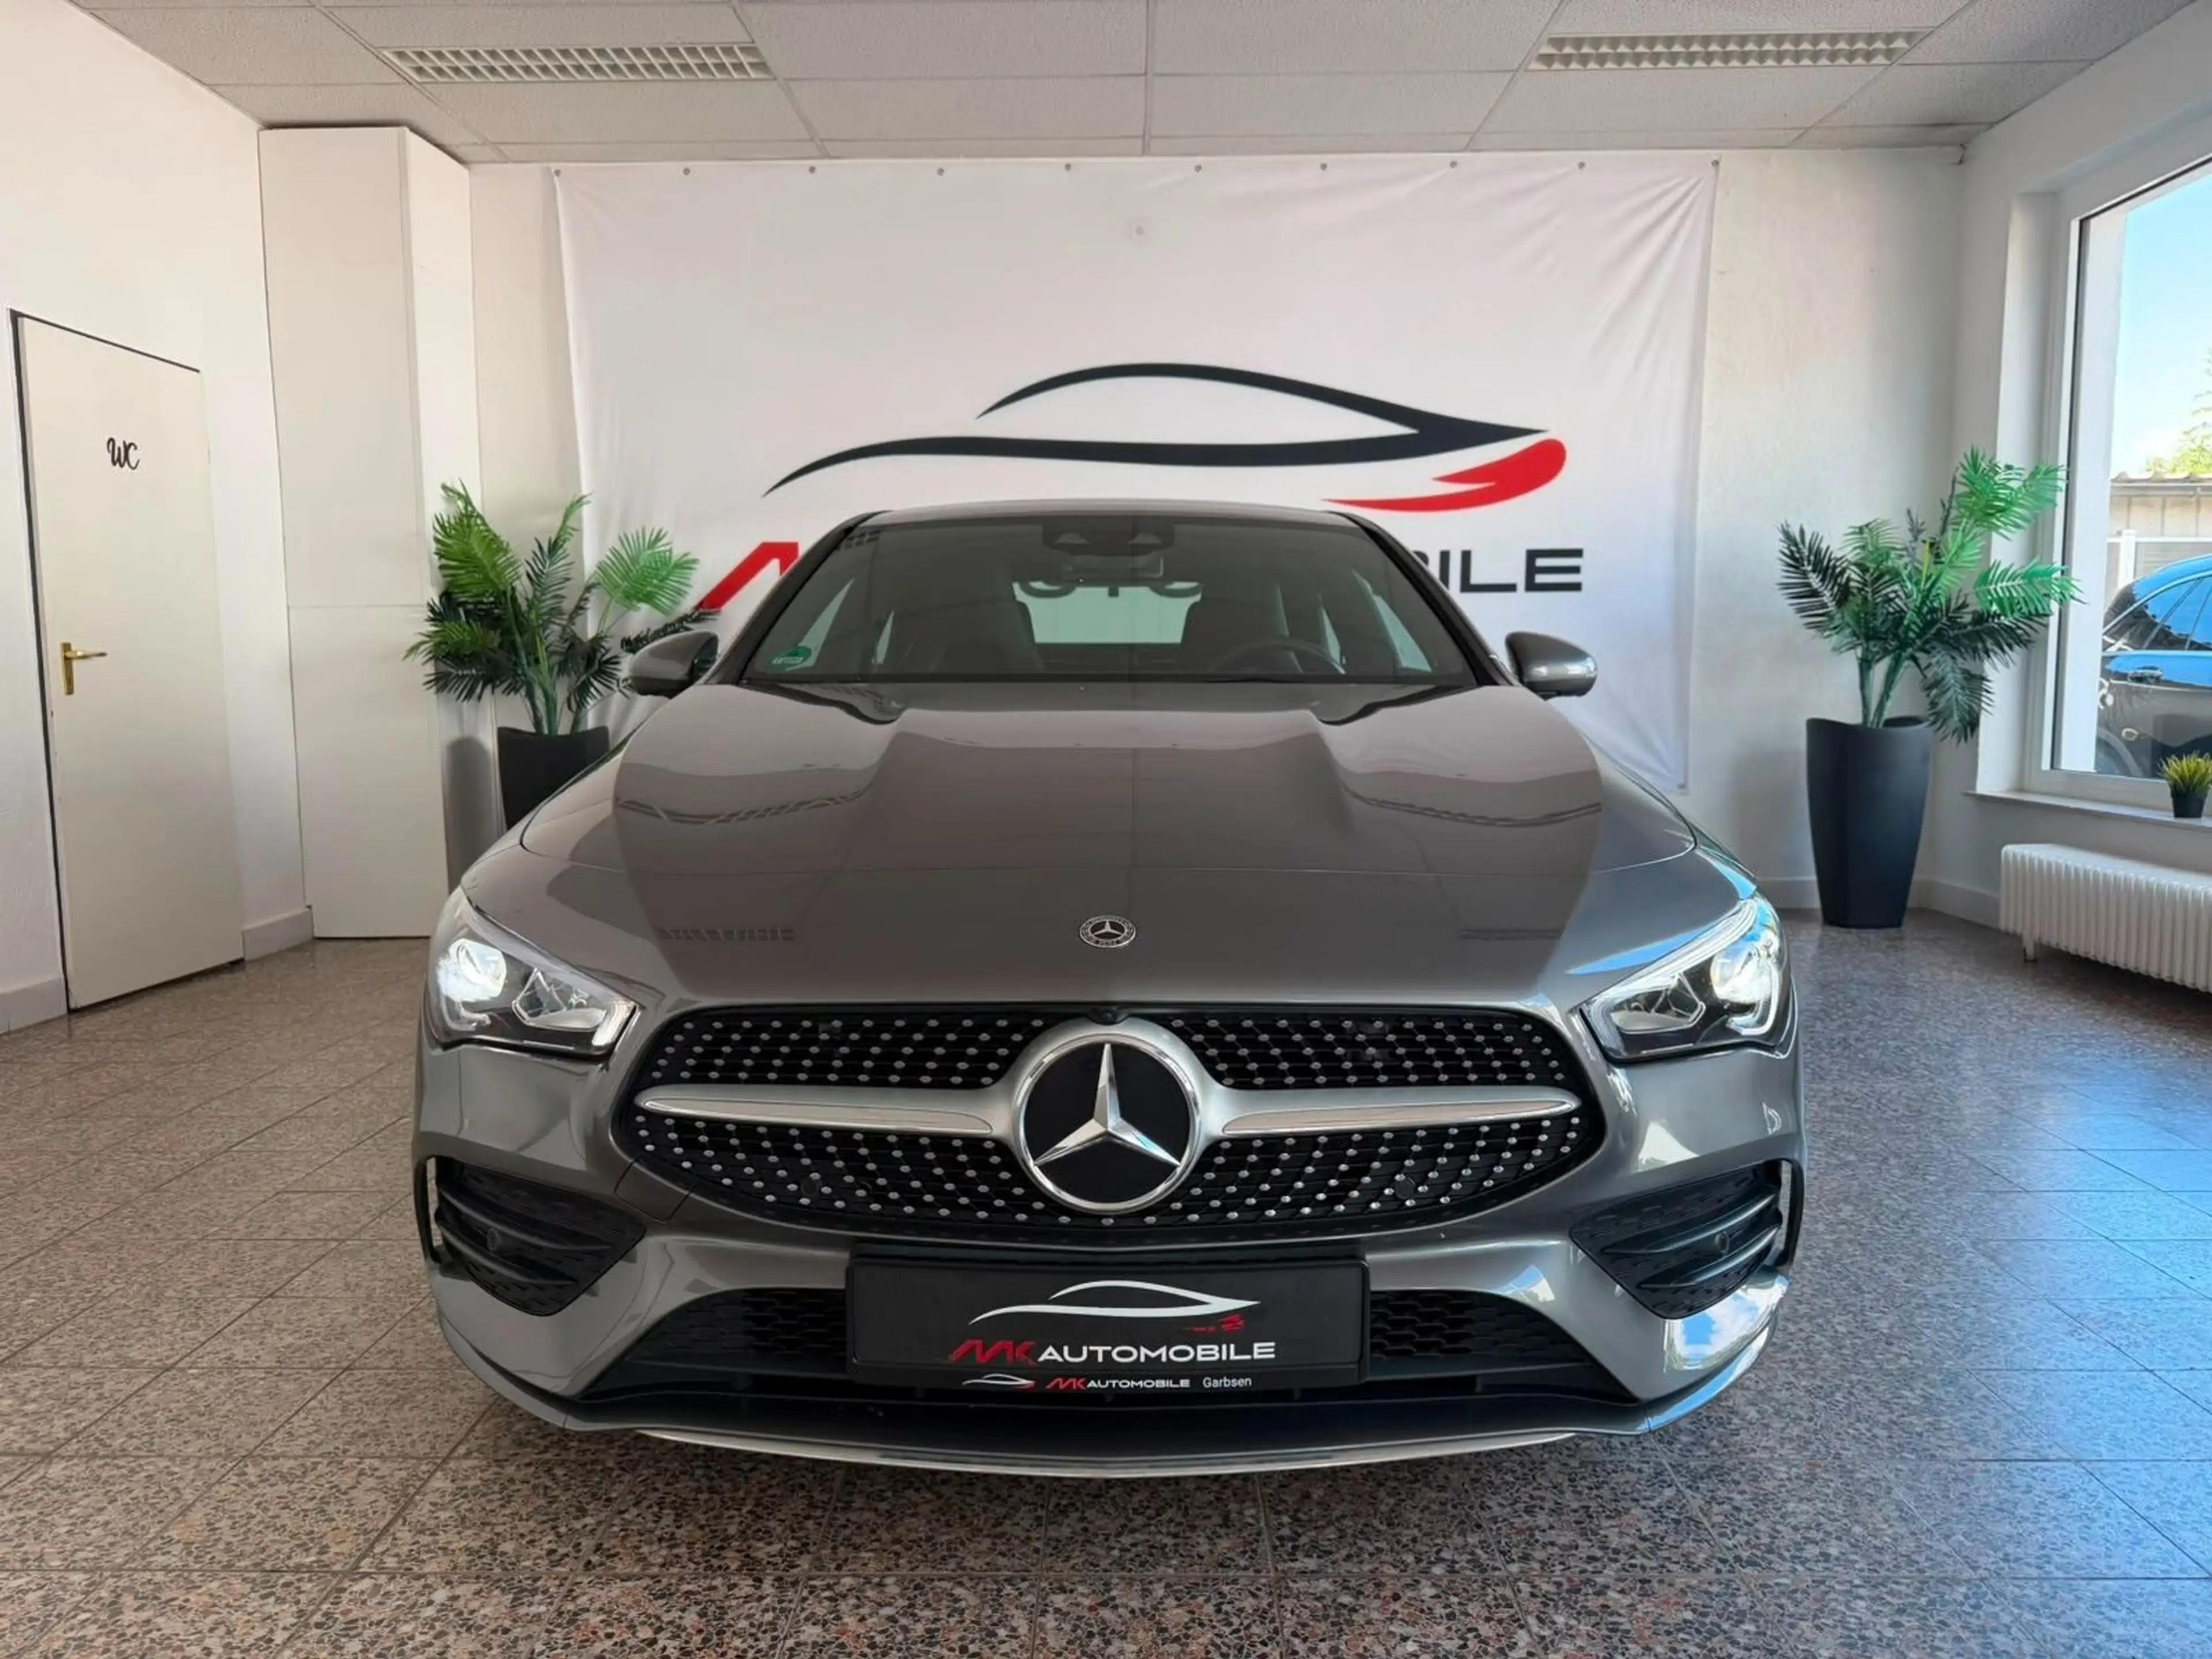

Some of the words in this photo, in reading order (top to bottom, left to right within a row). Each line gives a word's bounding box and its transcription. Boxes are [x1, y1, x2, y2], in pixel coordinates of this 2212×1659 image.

[106, 437, 140, 470] WC
[1038, 1342, 1275, 1363] AUTOMOBILE
[1086, 1379, 1191, 1389] AUTOMOBILE
[1202, 1376, 1252, 1389] Garbsen
